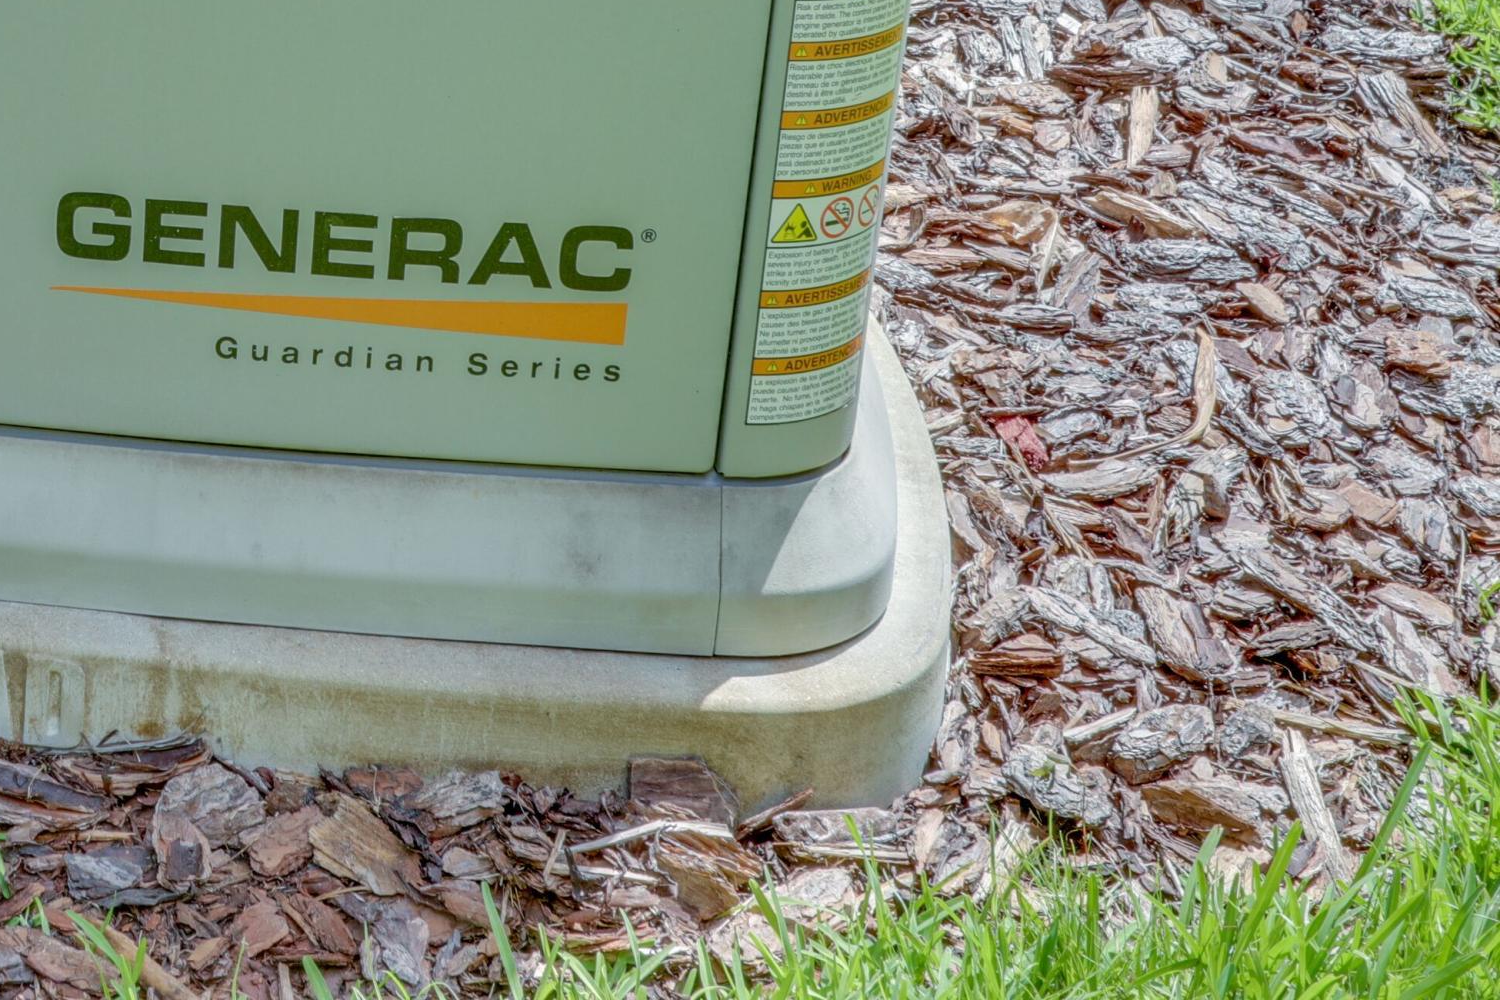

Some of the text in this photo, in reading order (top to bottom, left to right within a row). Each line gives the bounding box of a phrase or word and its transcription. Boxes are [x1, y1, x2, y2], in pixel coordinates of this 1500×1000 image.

[814, 28, 902, 57] AVERTISSEMEN
[822, 170, 873, 192] WARNING
[785, 274, 867, 305] AVERTISSEME
[214, 336, 623, 382] Guardian Series
[784, 340, 860, 371] ADVERTENC
